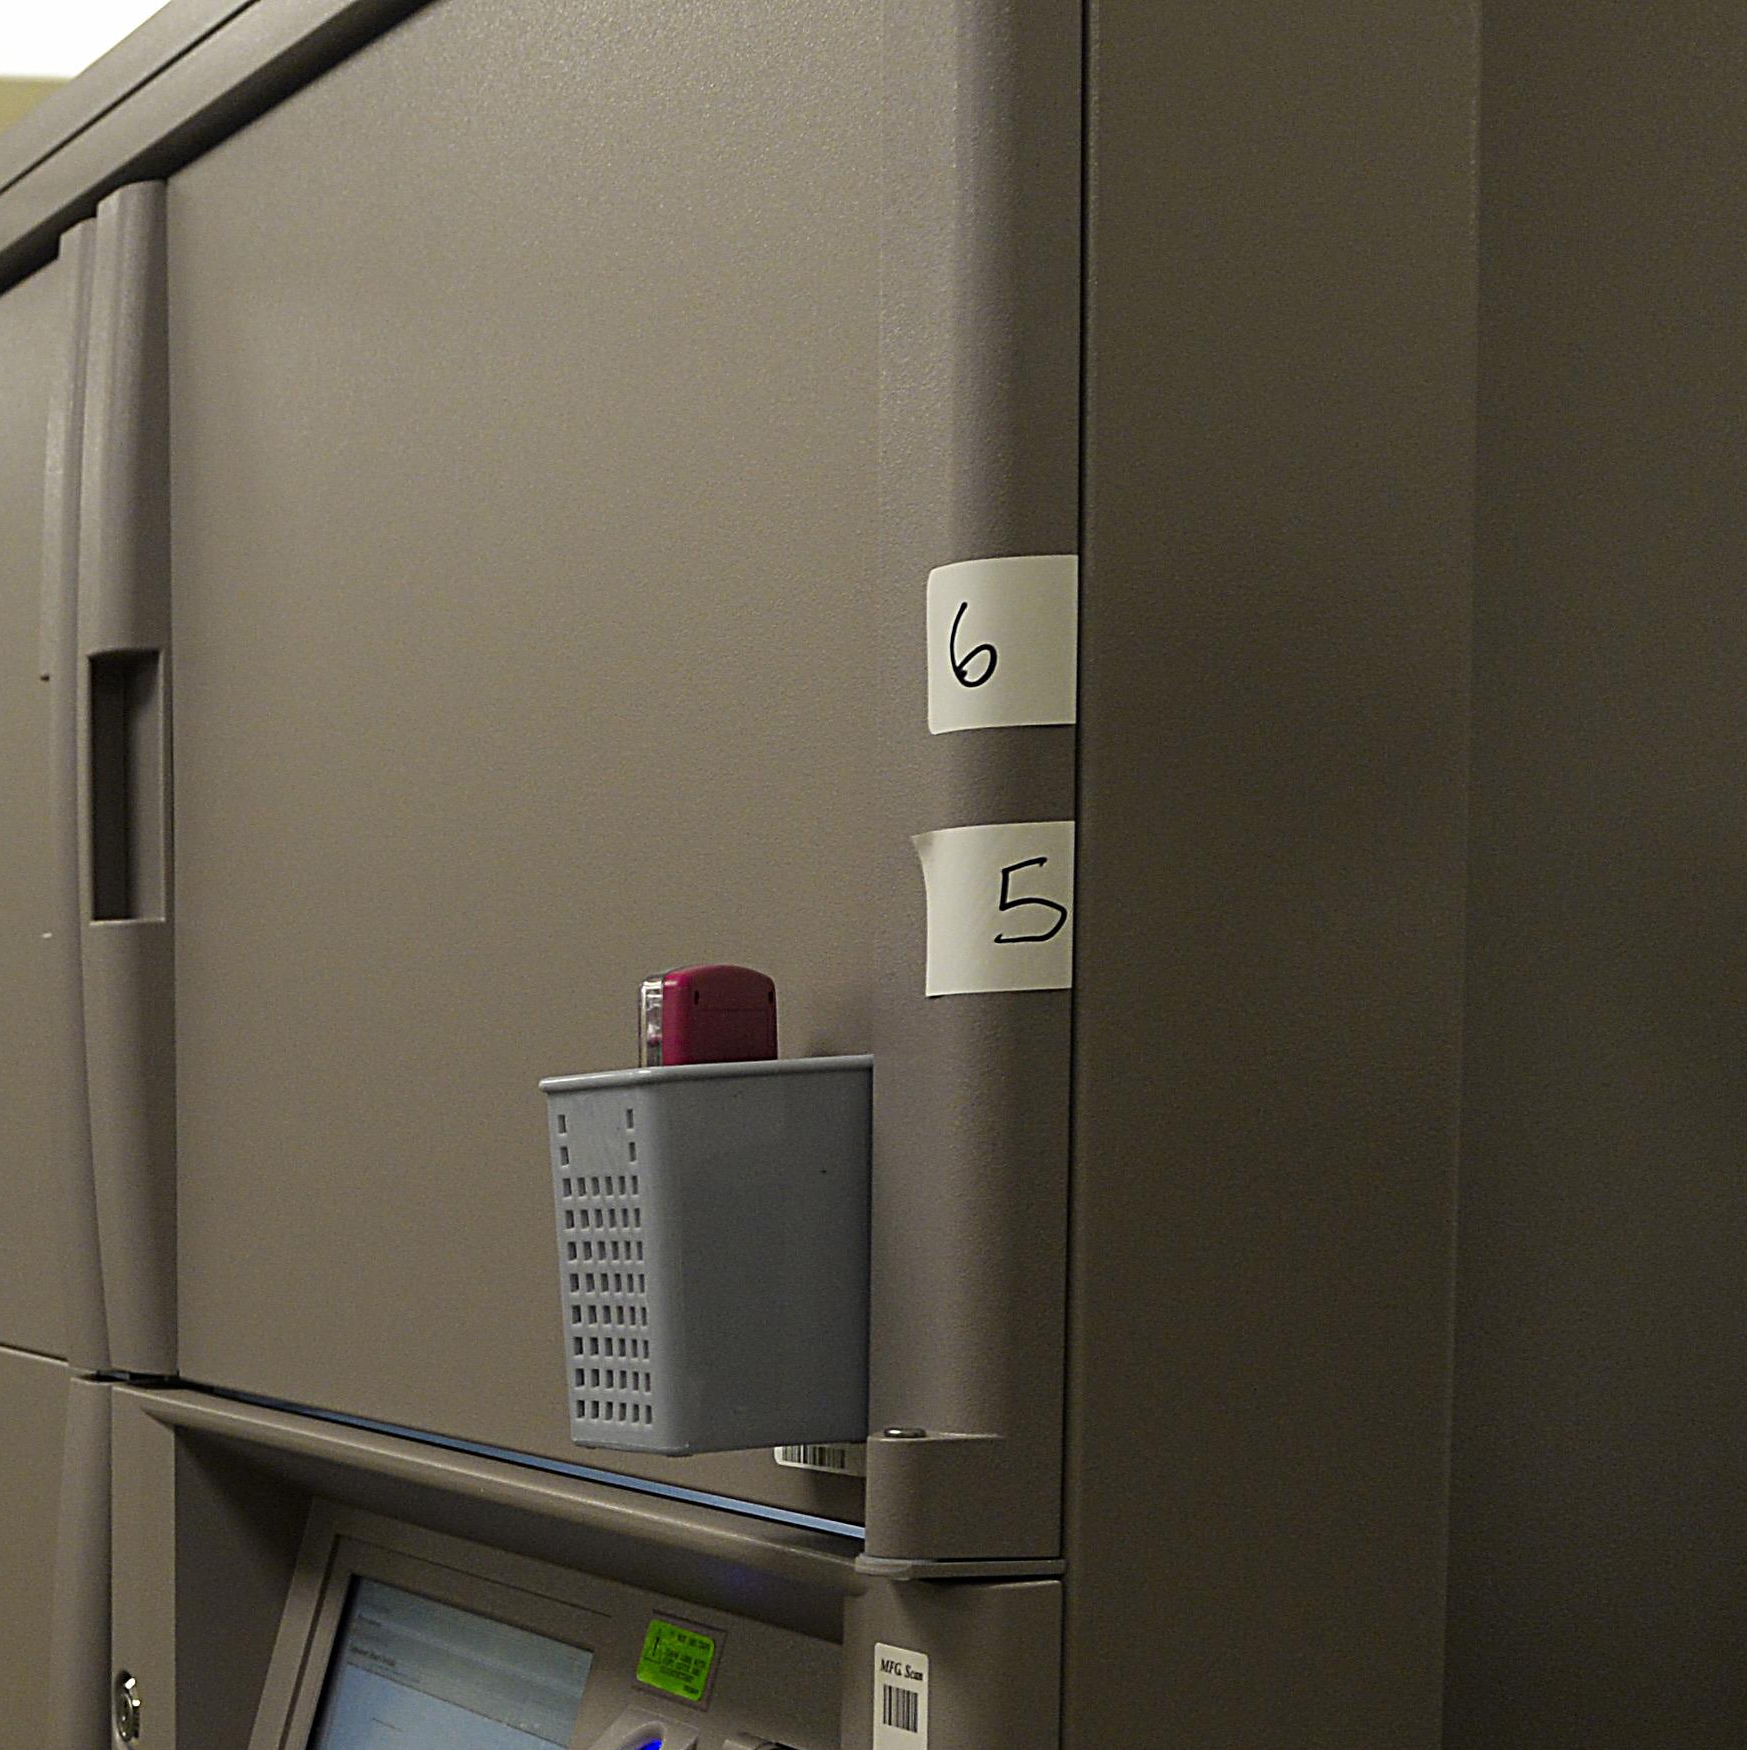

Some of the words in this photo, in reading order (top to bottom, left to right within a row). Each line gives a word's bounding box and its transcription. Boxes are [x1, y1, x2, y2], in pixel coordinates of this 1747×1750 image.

[949, 600, 998, 689] 6
[993, 856, 1069, 944] 5
[904, 1661, 924, 1682] Scan
